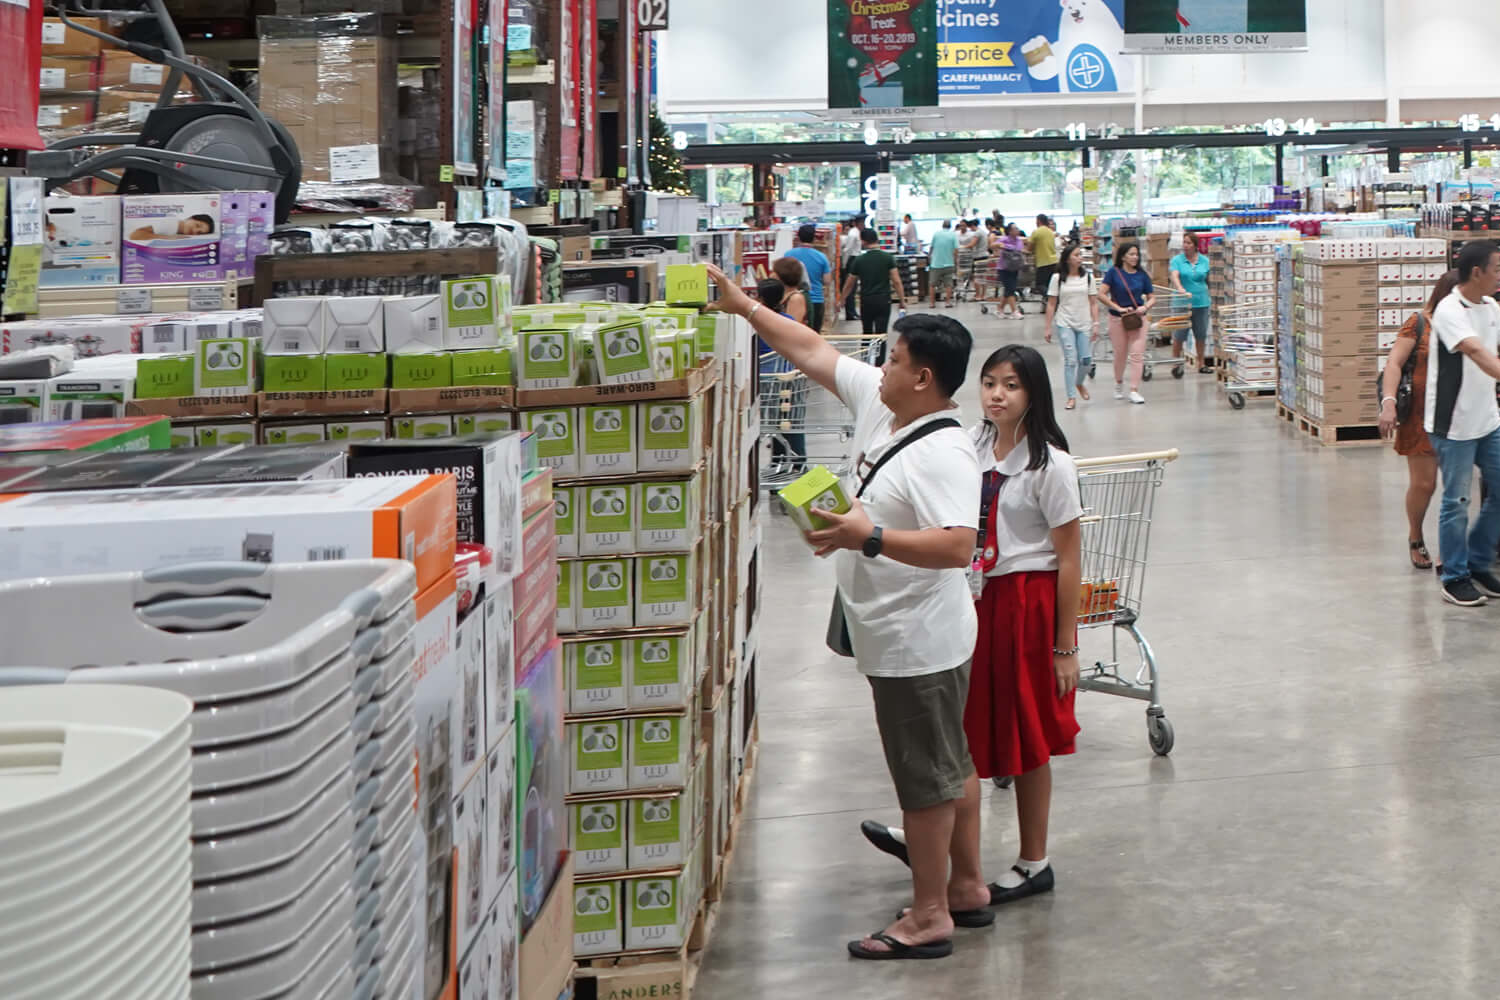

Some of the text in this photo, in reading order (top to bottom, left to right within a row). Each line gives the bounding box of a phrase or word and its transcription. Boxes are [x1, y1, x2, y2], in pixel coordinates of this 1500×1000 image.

[851, 0, 910, 15] Christmas
[868, 16, 896, 30] Treat
[851, 34, 870, 44] OCT.
[1165, 34, 1269, 45] MEMBERS ONLY
[955, 45, 1004, 65] price
[942, 73, 1023, 82] CARE PHARMACY
[1264, 118, 1317, 136] 13 14
[1459, 113, 1480, 132] 15
[1065, 123, 1086, 141] 11
[673, 131, 689, 150] 8
[159, 271, 184, 280] KING
